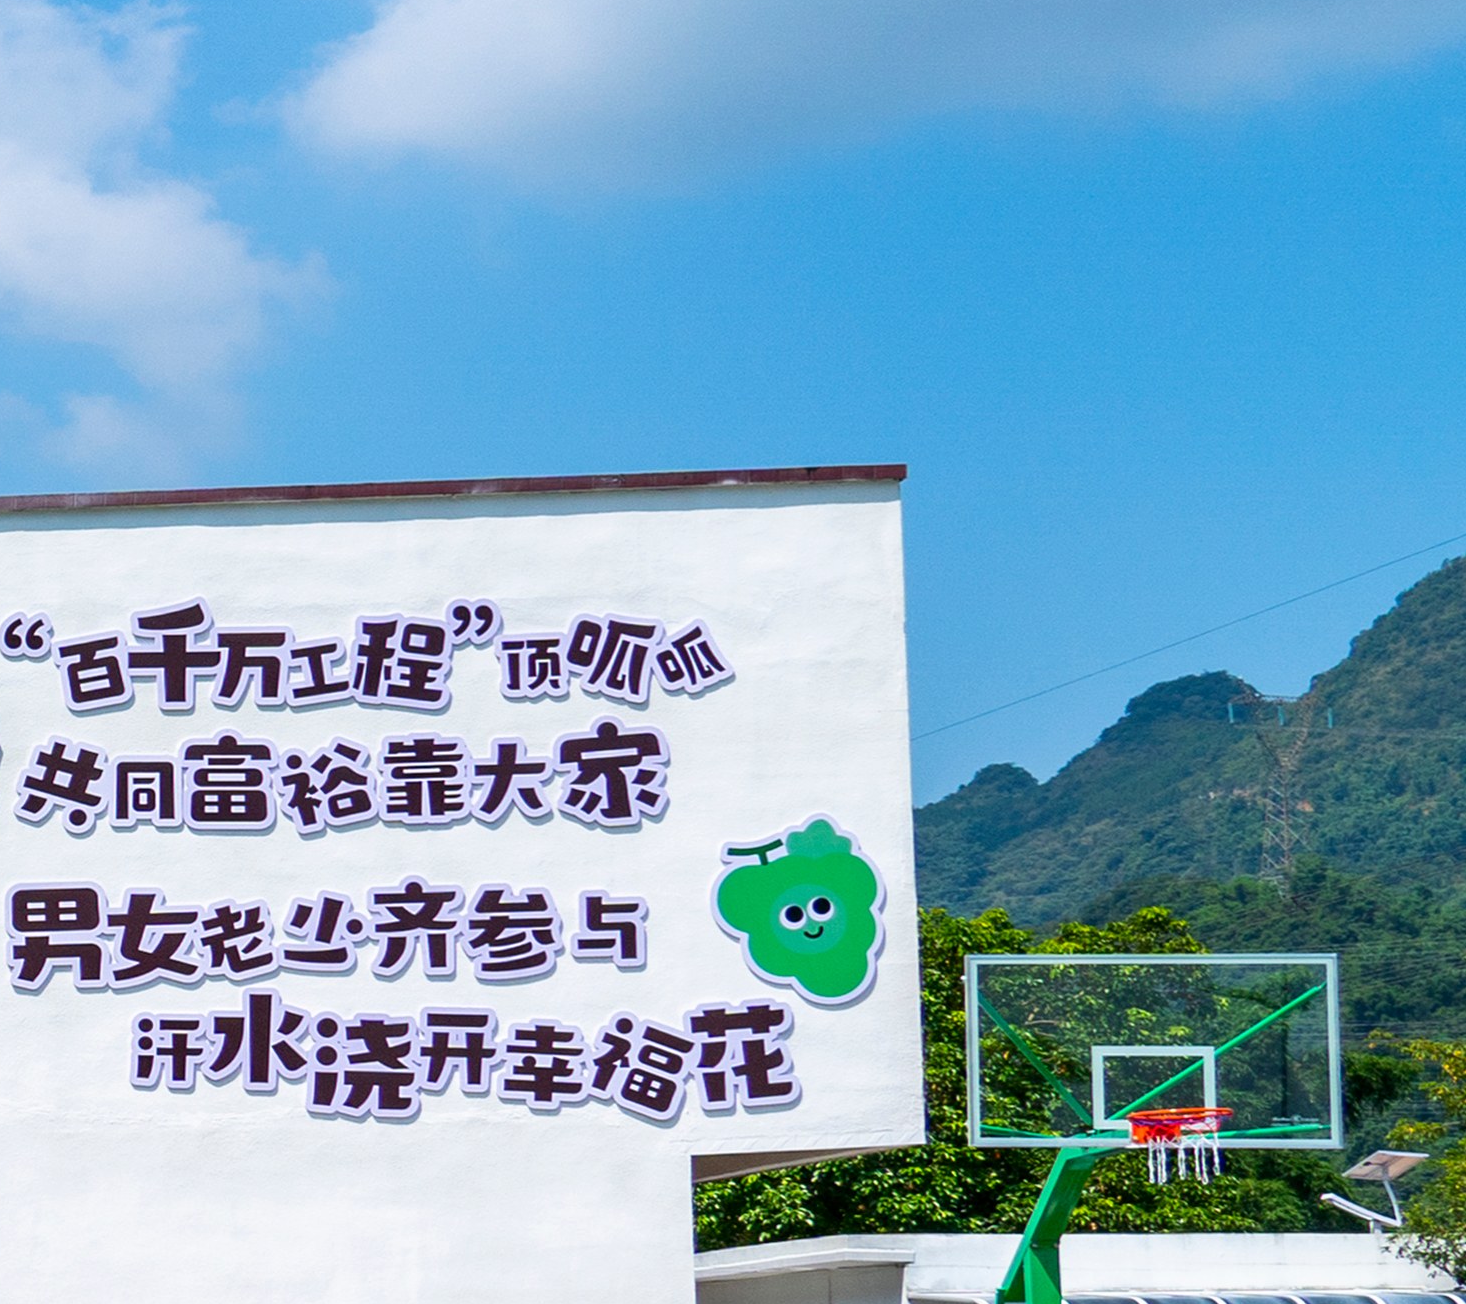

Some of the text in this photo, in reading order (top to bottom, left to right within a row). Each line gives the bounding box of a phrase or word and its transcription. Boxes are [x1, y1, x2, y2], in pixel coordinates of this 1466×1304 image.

[21, 723, 661, 826] 共同富裕靠大家
[13, 883, 639, 981] 男女老少齐参与
[137, 994, 793, 1112] 汗水浇开幸福花
